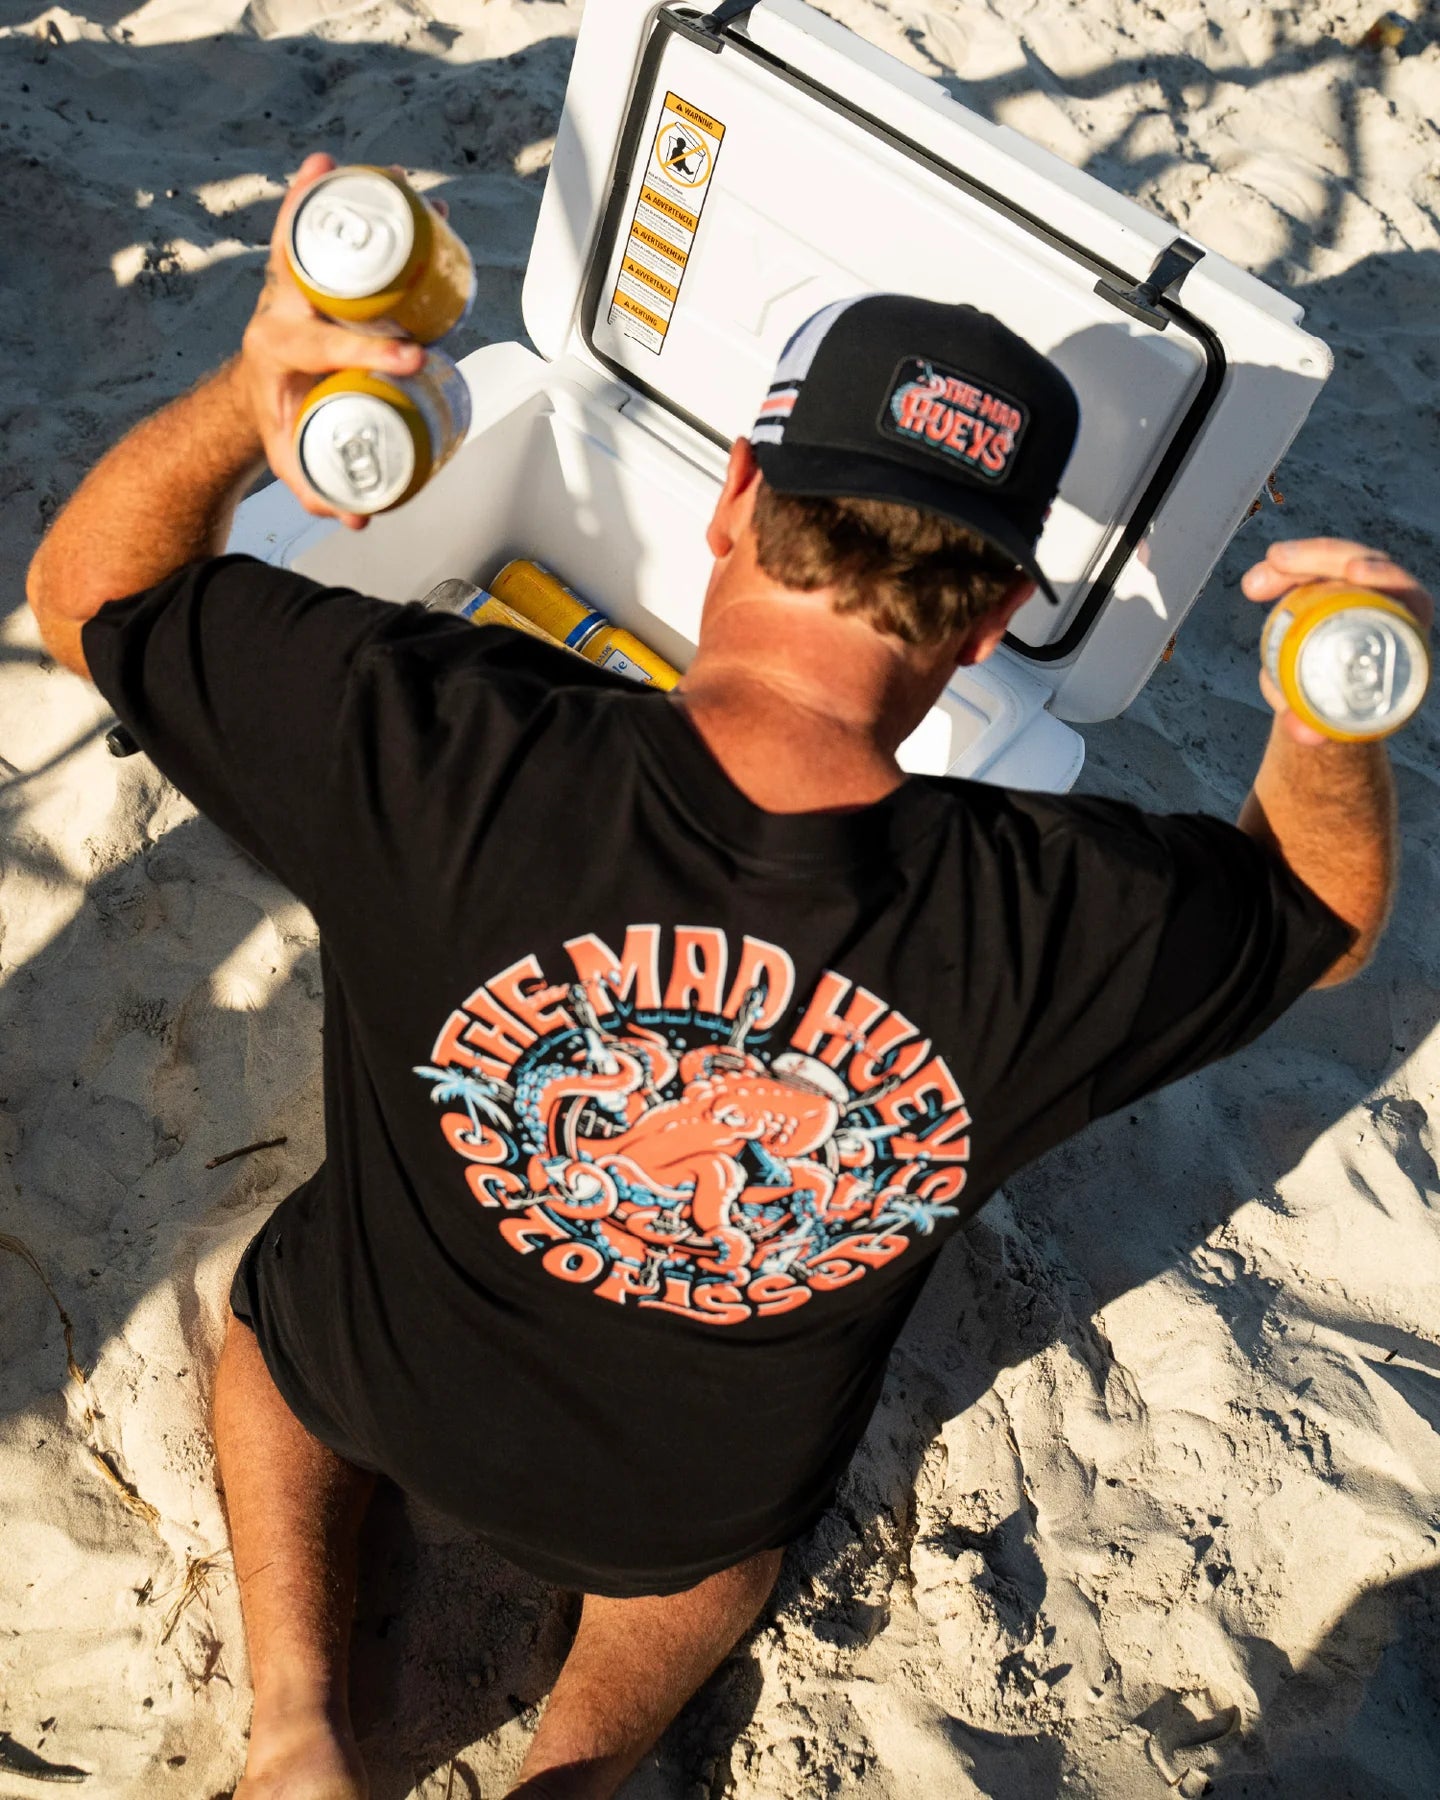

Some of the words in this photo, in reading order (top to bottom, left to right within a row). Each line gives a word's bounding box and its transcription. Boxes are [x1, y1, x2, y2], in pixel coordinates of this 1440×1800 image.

[684, 106, 713, 131] WARNING
[652, 195, 693, 229] ADVERTENCIA
[640, 230, 686, 265] AVERTISSEMENT
[634, 267, 671, 297] AVVERTENZA
[630, 304, 658, 328] ACHTUNG
[945, 376, 982, 411] THE
[978, 393, 1022, 433] MAD
[897, 396, 1006, 472] HUEYS
[430, 954, 578, 1078] THE
[563, 923, 795, 1030] MAD
